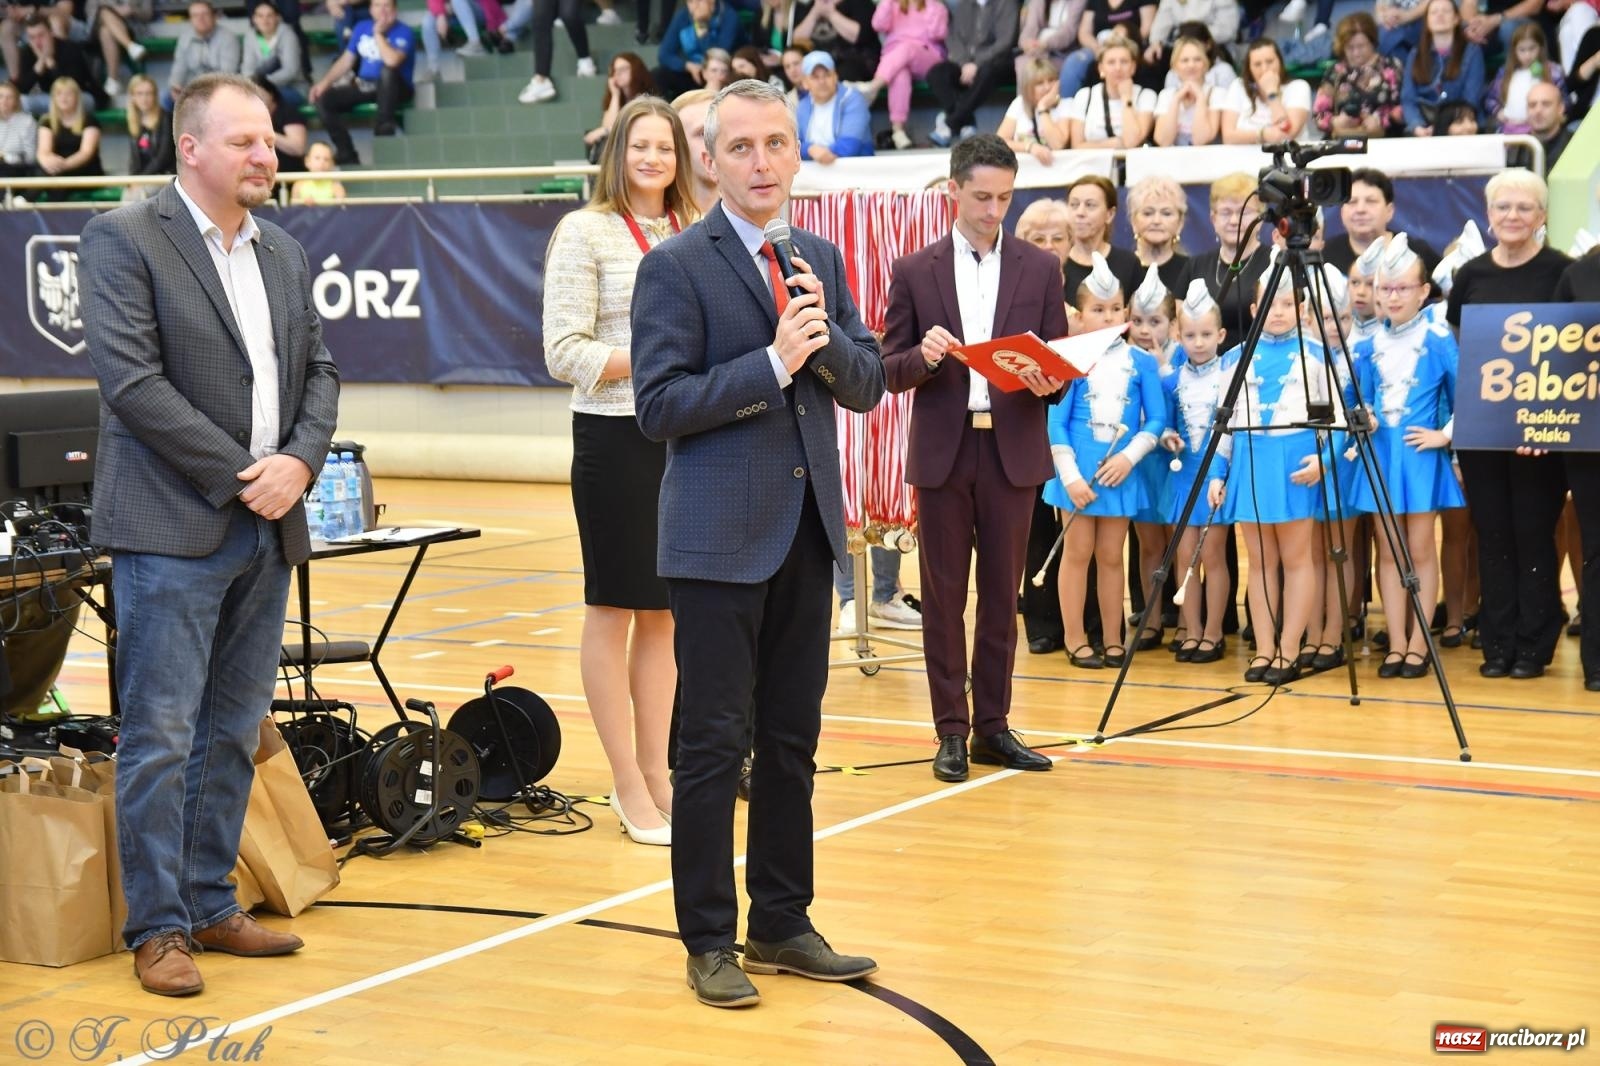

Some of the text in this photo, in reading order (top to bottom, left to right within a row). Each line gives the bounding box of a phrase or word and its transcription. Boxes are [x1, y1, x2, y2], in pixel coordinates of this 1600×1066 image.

[312, 253, 422, 321] ÓRZ
[1480, 358, 1600, 402] Babci
[1516, 408, 1581, 424] Racibórz
[1524, 426, 1571, 443] Polska
